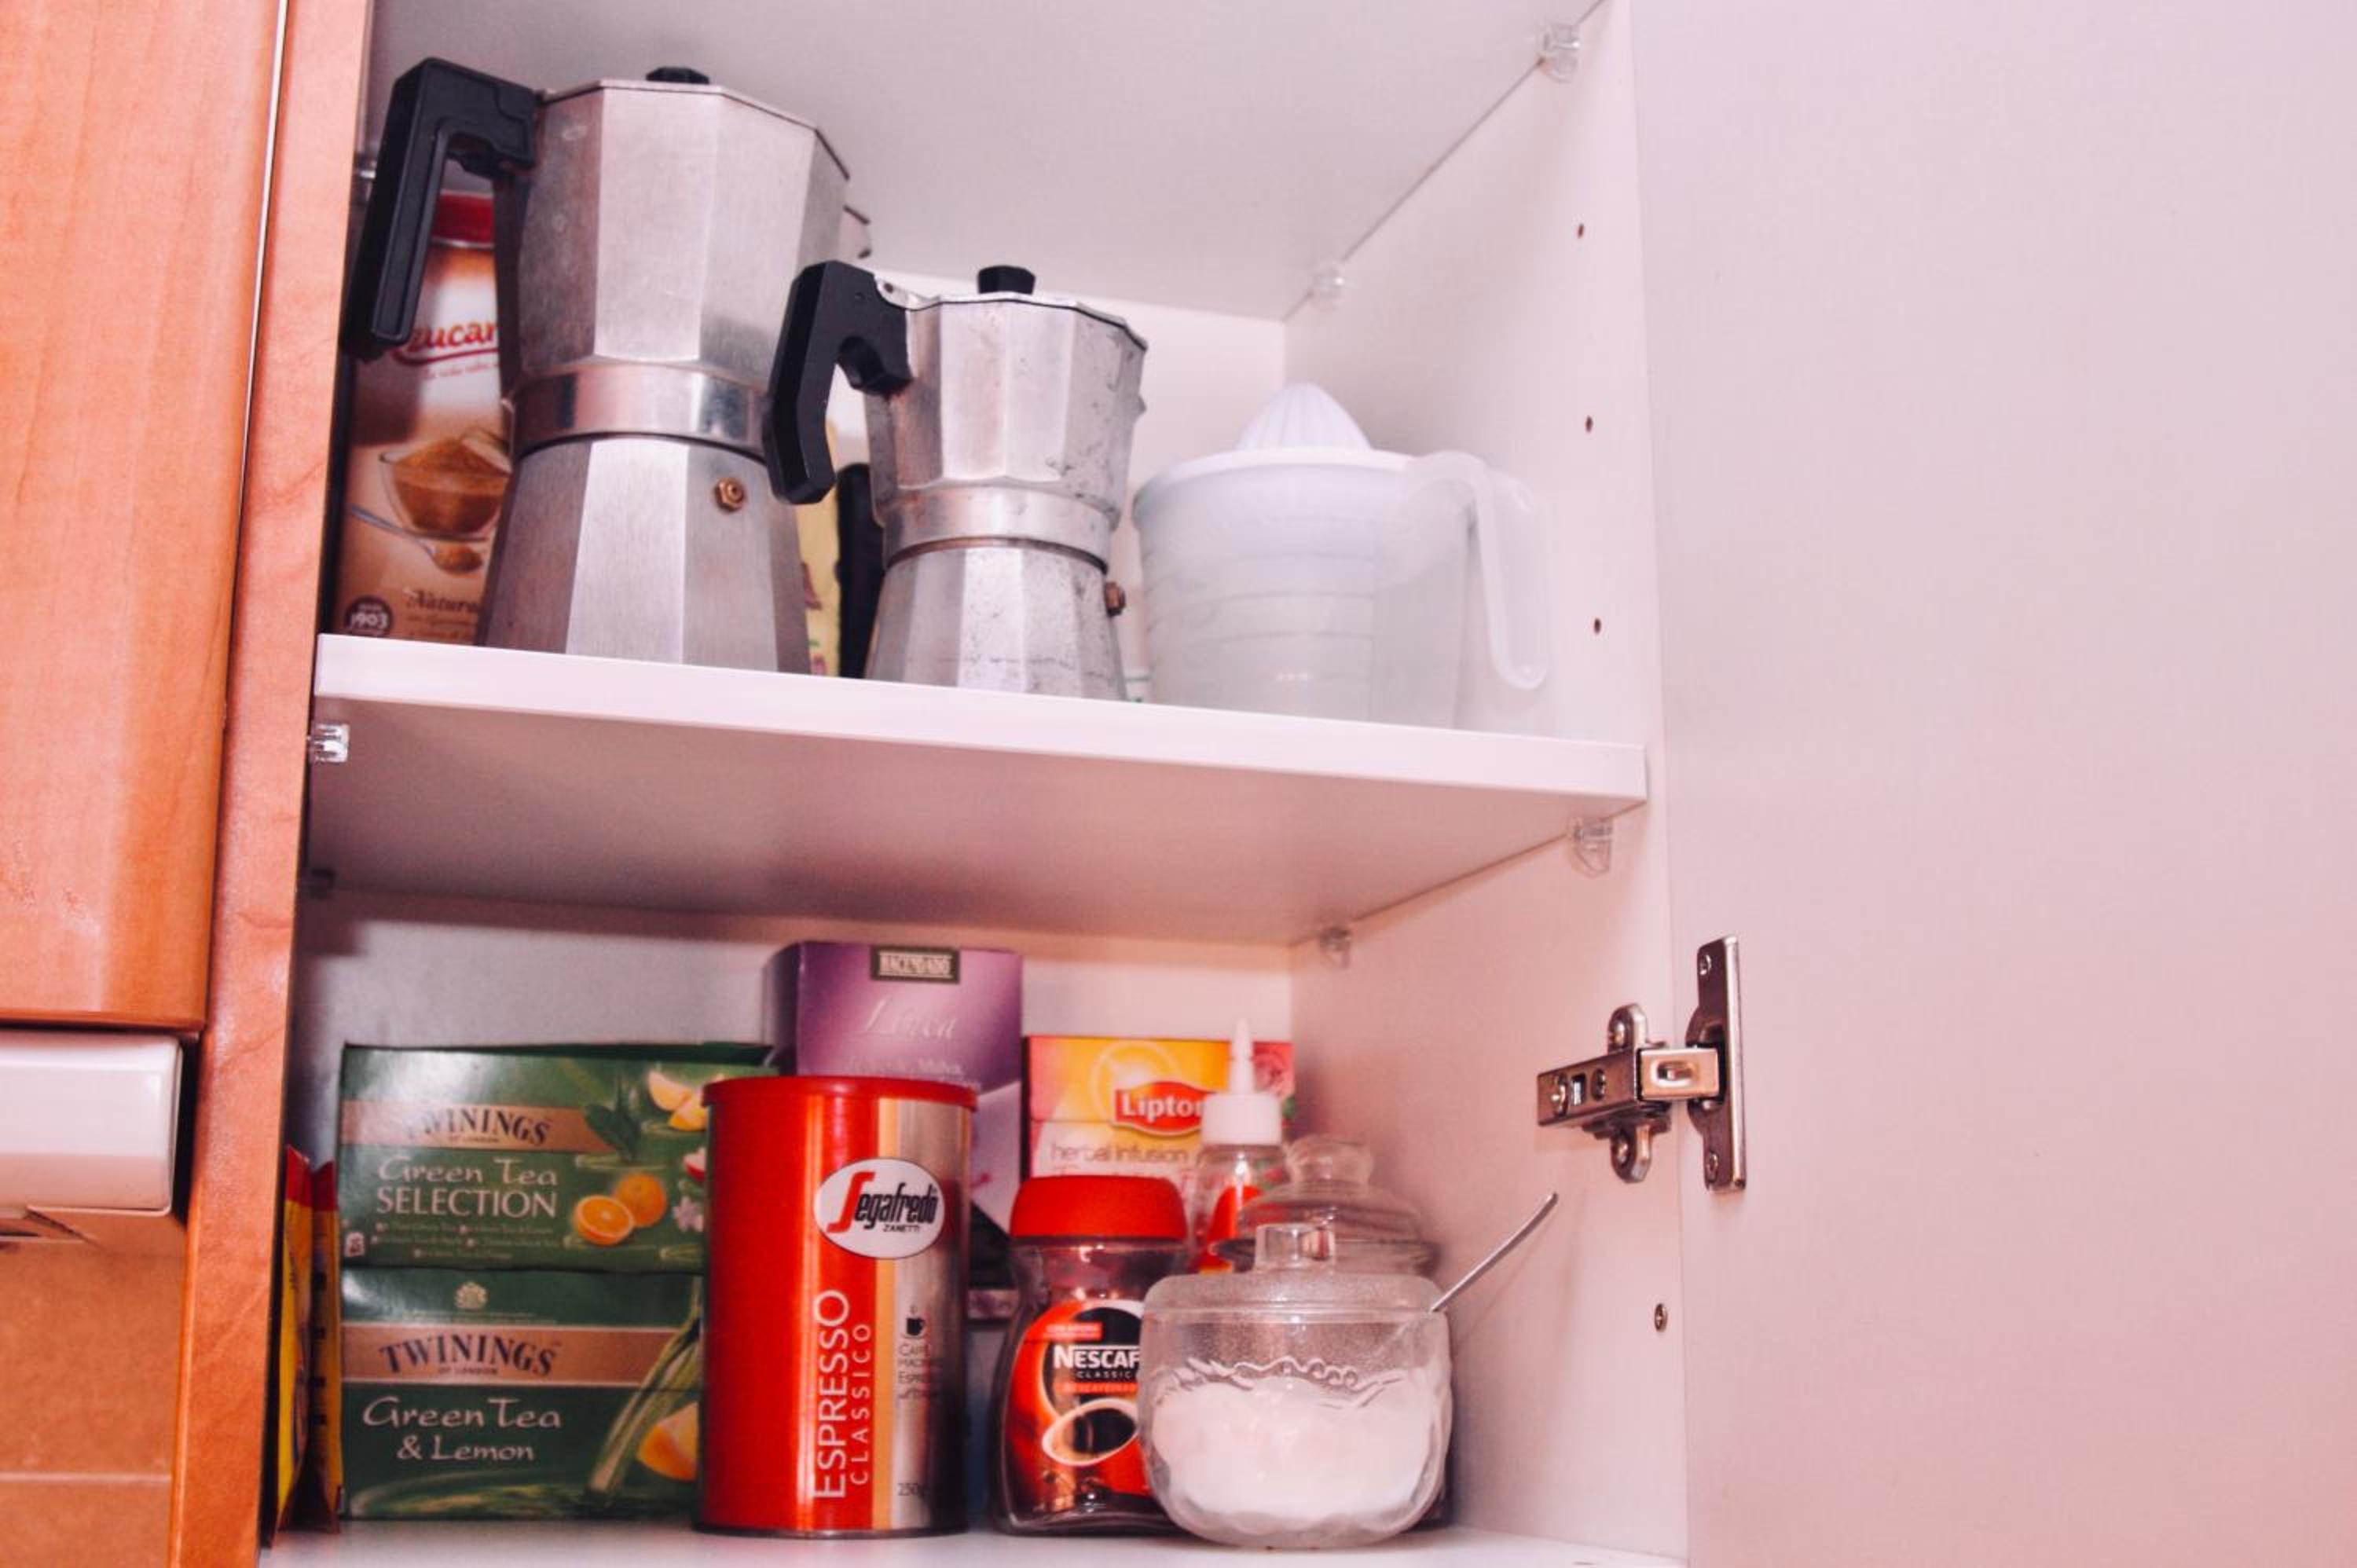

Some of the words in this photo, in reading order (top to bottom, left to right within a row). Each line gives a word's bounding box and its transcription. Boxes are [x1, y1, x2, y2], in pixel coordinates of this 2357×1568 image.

[405, 321, 497, 353] zucar
[351, 611, 390, 629] 1903
[404, 1106, 552, 1145] WININGS
[377, 1156, 484, 1183] Green
[494, 1156, 558, 1186] Tea
[376, 1186, 558, 1218] SELECTION
[827, 1171, 938, 1233] Segafredo
[379, 1334, 555, 1376] TWININGS
[1054, 1344, 1140, 1369] NESCAF
[1076, 1370, 1132, 1379] CLASSIC
[812, 1288, 850, 1499] ESPRESSO
[851, 1323, 872, 1486] CLASSICO
[363, 1395, 485, 1430] Green
[487, 1398, 563, 1429] Tea
[397, 1434, 422, 1461] &
[431, 1434, 535, 1461] Lemon
